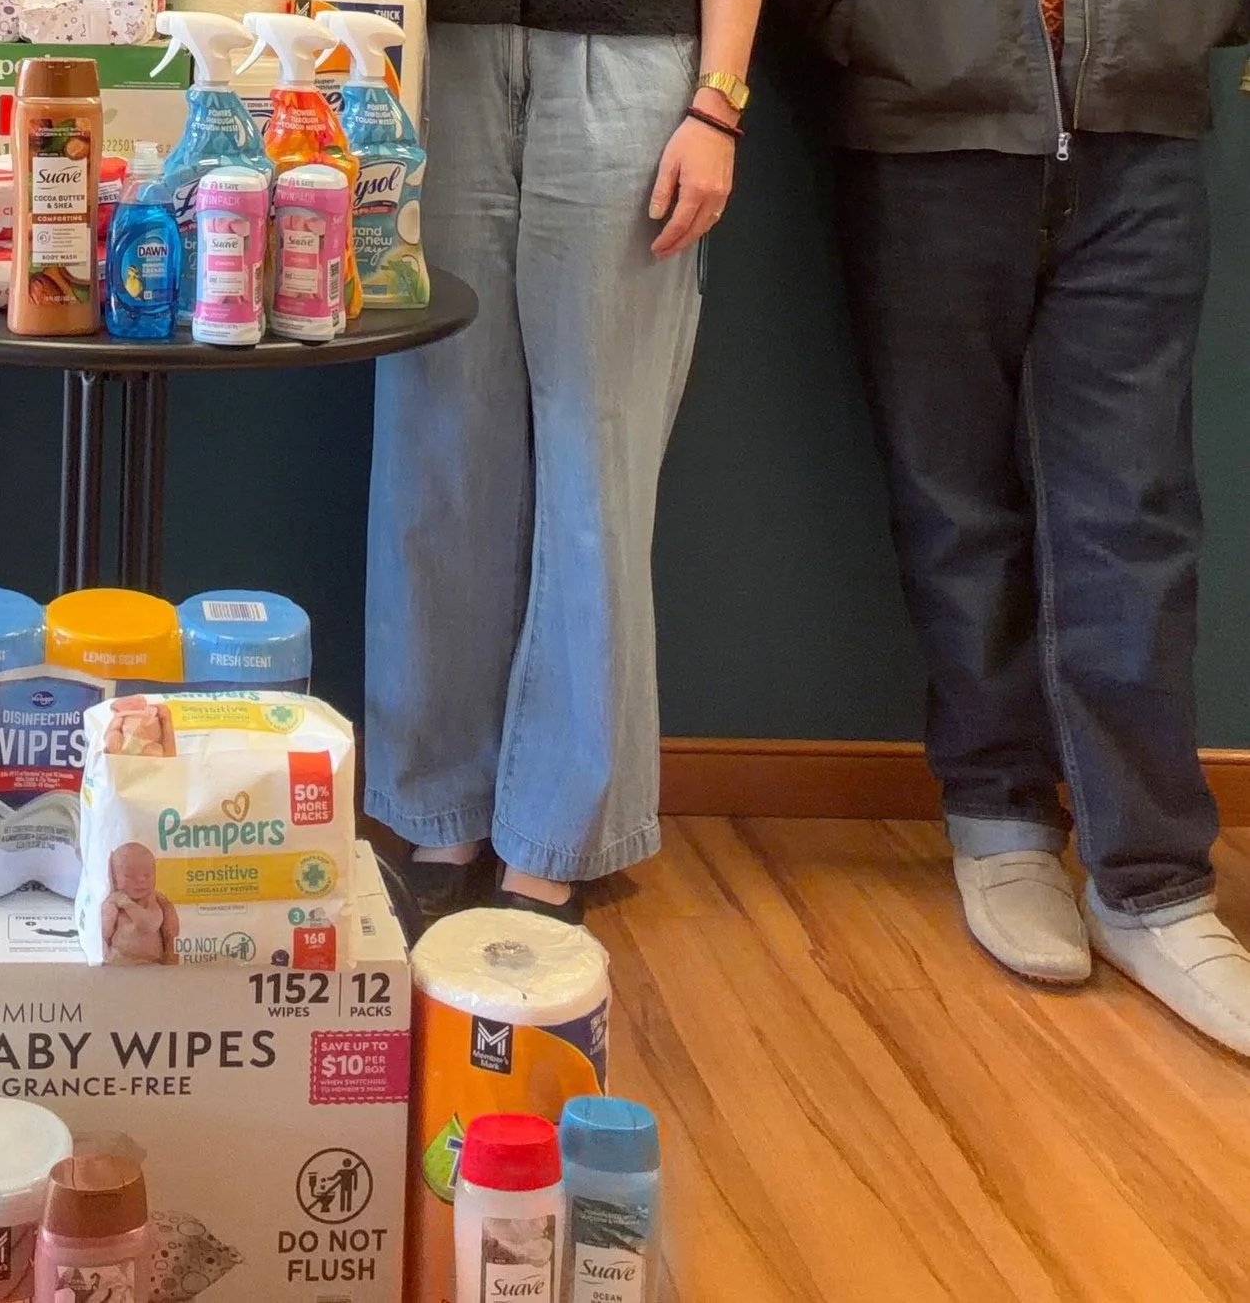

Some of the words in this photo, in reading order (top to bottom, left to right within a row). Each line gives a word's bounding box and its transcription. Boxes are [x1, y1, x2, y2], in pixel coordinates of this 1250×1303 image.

[36, 168, 82, 184] Suave
[354, 166, 399, 205] ysol
[352, 225, 383, 237] rand
[211, 237, 239, 249] Suave
[365, 236, 393, 246] new
[138, 246, 168, 258] DAWN
[82, 650, 117, 666] LEMON
[209, 652, 242, 667] FRESH
[244, 654, 272, 669] SCENT
[2, 709, 81, 726] DISINFECTING
[293, 783, 330, 802] 50%
[296, 801, 329, 812] MORE
[293, 810, 330, 822] PACKS
[158, 807, 285, 854] Pampers
[186, 864, 259, 882] sensitive
[292, 910, 301, 923] 3
[175, 938, 192, 954] DO
[194, 937, 218, 953] NOT
[303, 932, 327, 945] 168
[183, 952, 218, 965] FLUSH
[249, 972, 331, 1005] 1152
[351, 972, 391, 1004] 12
[268, 1006, 310, 1019] WIPES
[350, 1006, 393, 1018] PACKS
[110, 1030, 277, 1070] WIPES
[320, 1041, 351, 1052] SAVE
[352, 1041, 370, 1052] UP
[371, 1040, 389, 1051] TO
[472, 1048, 510, 1066] Member's
[480, 1058, 500, 1071] Mark
[321, 1053, 364, 1078] $10
[364, 1055, 387, 1065] PER
[364, 1064, 387, 1074] BOX
[277, 1229, 319, 1254] DO
[329, 1228, 388, 1253] NOT
[287, 1257, 376, 1283] FLUSH
[579, 1258, 637, 1282] Suave
[490, 1278, 545, 1297] Suave
[592, 1291, 623, 1303] OCEAN
